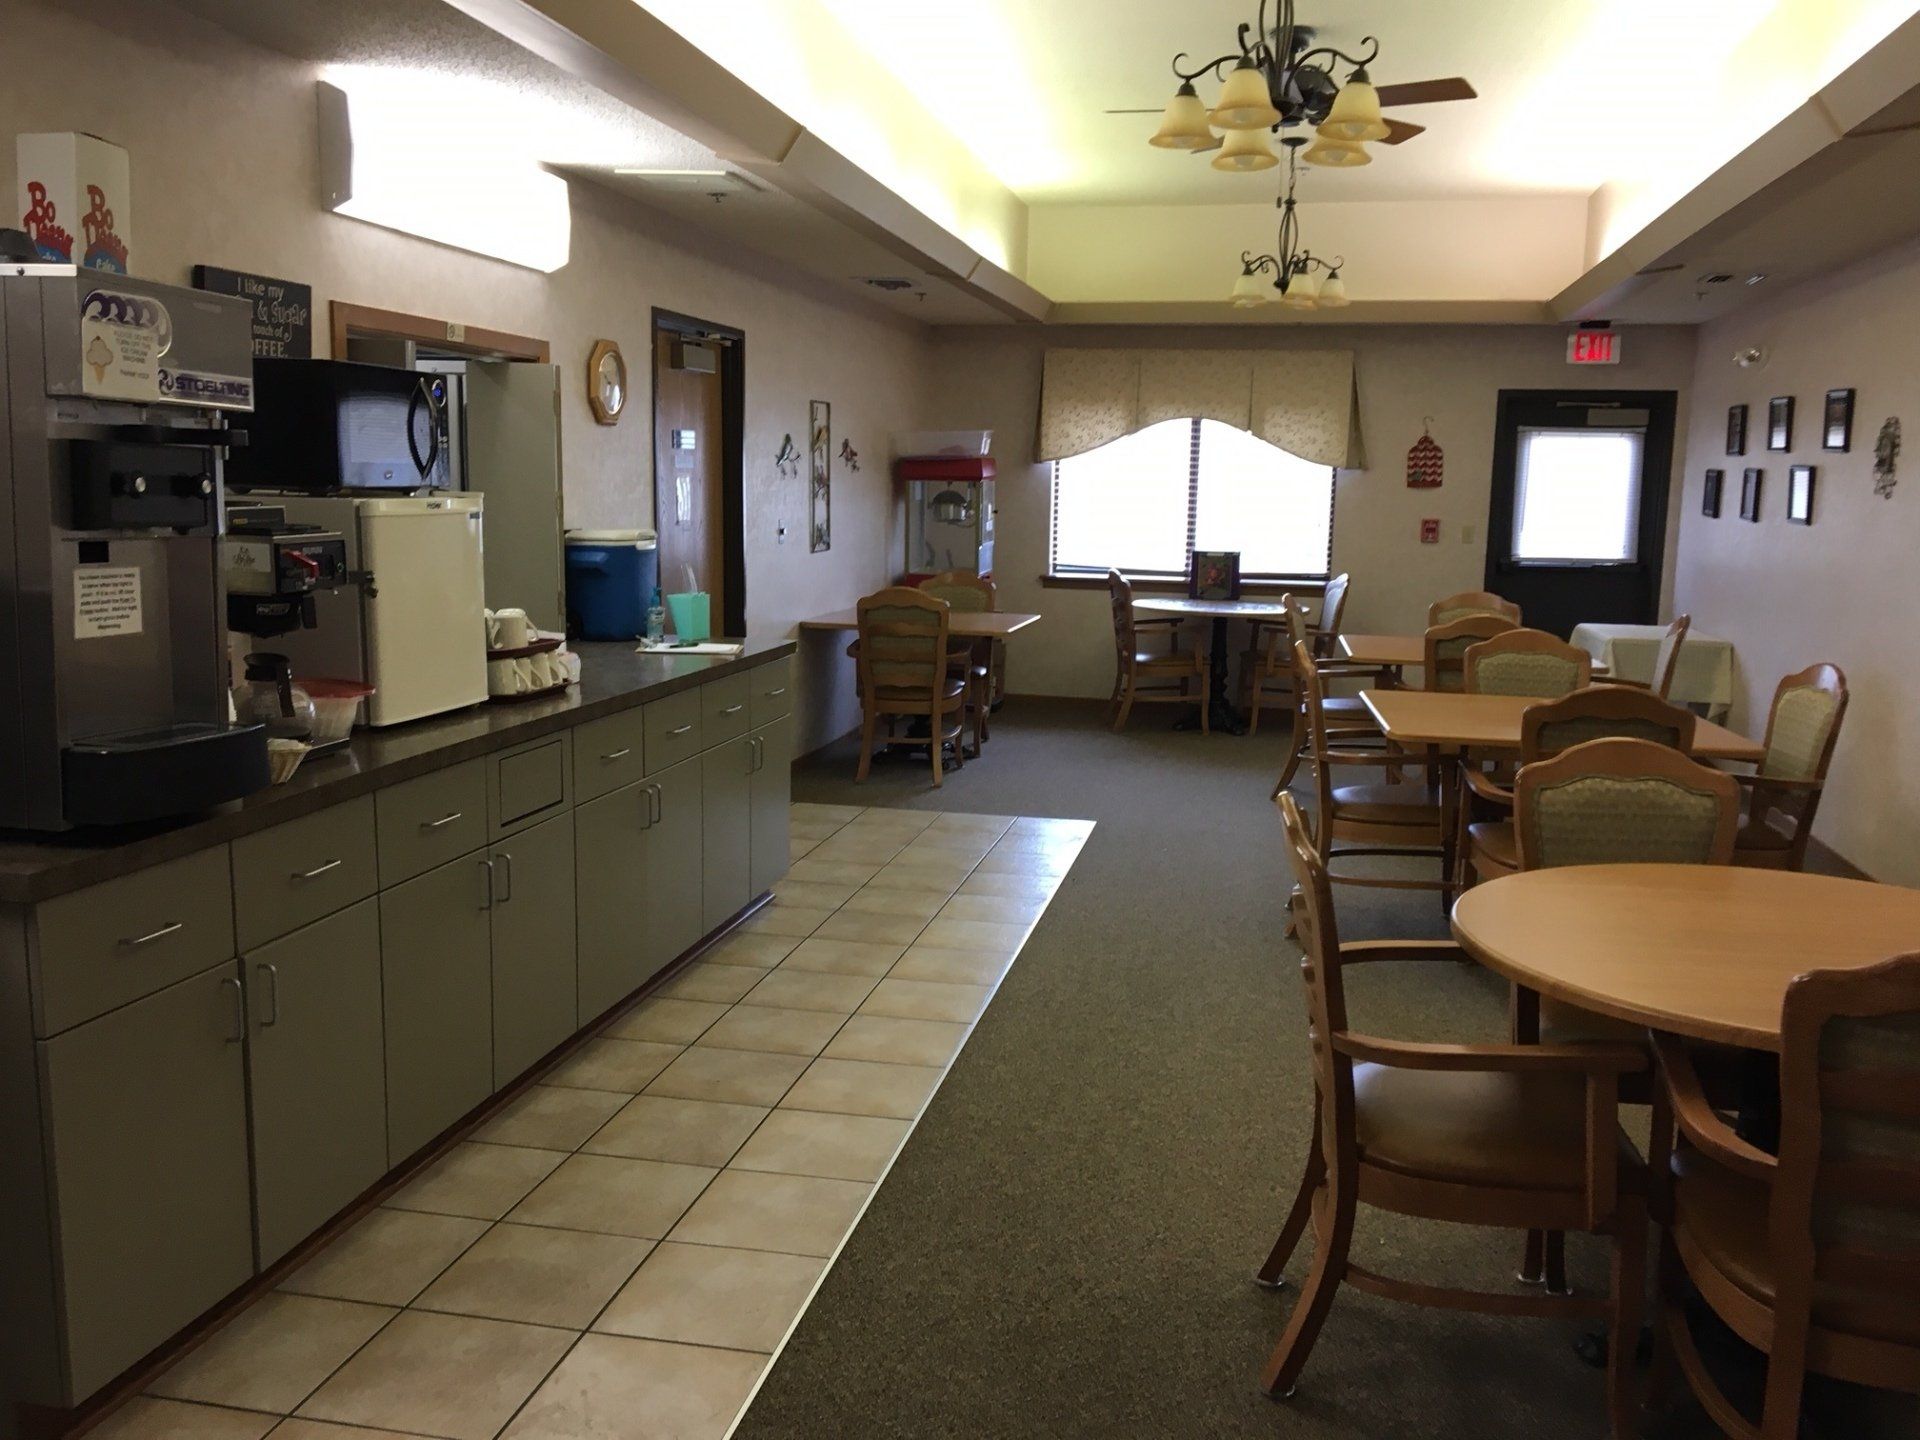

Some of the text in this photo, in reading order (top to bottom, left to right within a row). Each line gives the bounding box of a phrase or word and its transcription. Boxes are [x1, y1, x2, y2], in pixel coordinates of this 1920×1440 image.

[27, 181, 56, 223] Bo
[86, 185, 113, 230] Bo
[237, 277, 285, 301] I like my
[257, 301, 269, 324] &
[274, 326, 284, 338] of
[1574, 330, 1616, 362] EXIT
[175, 376, 251, 396] STOELTING
